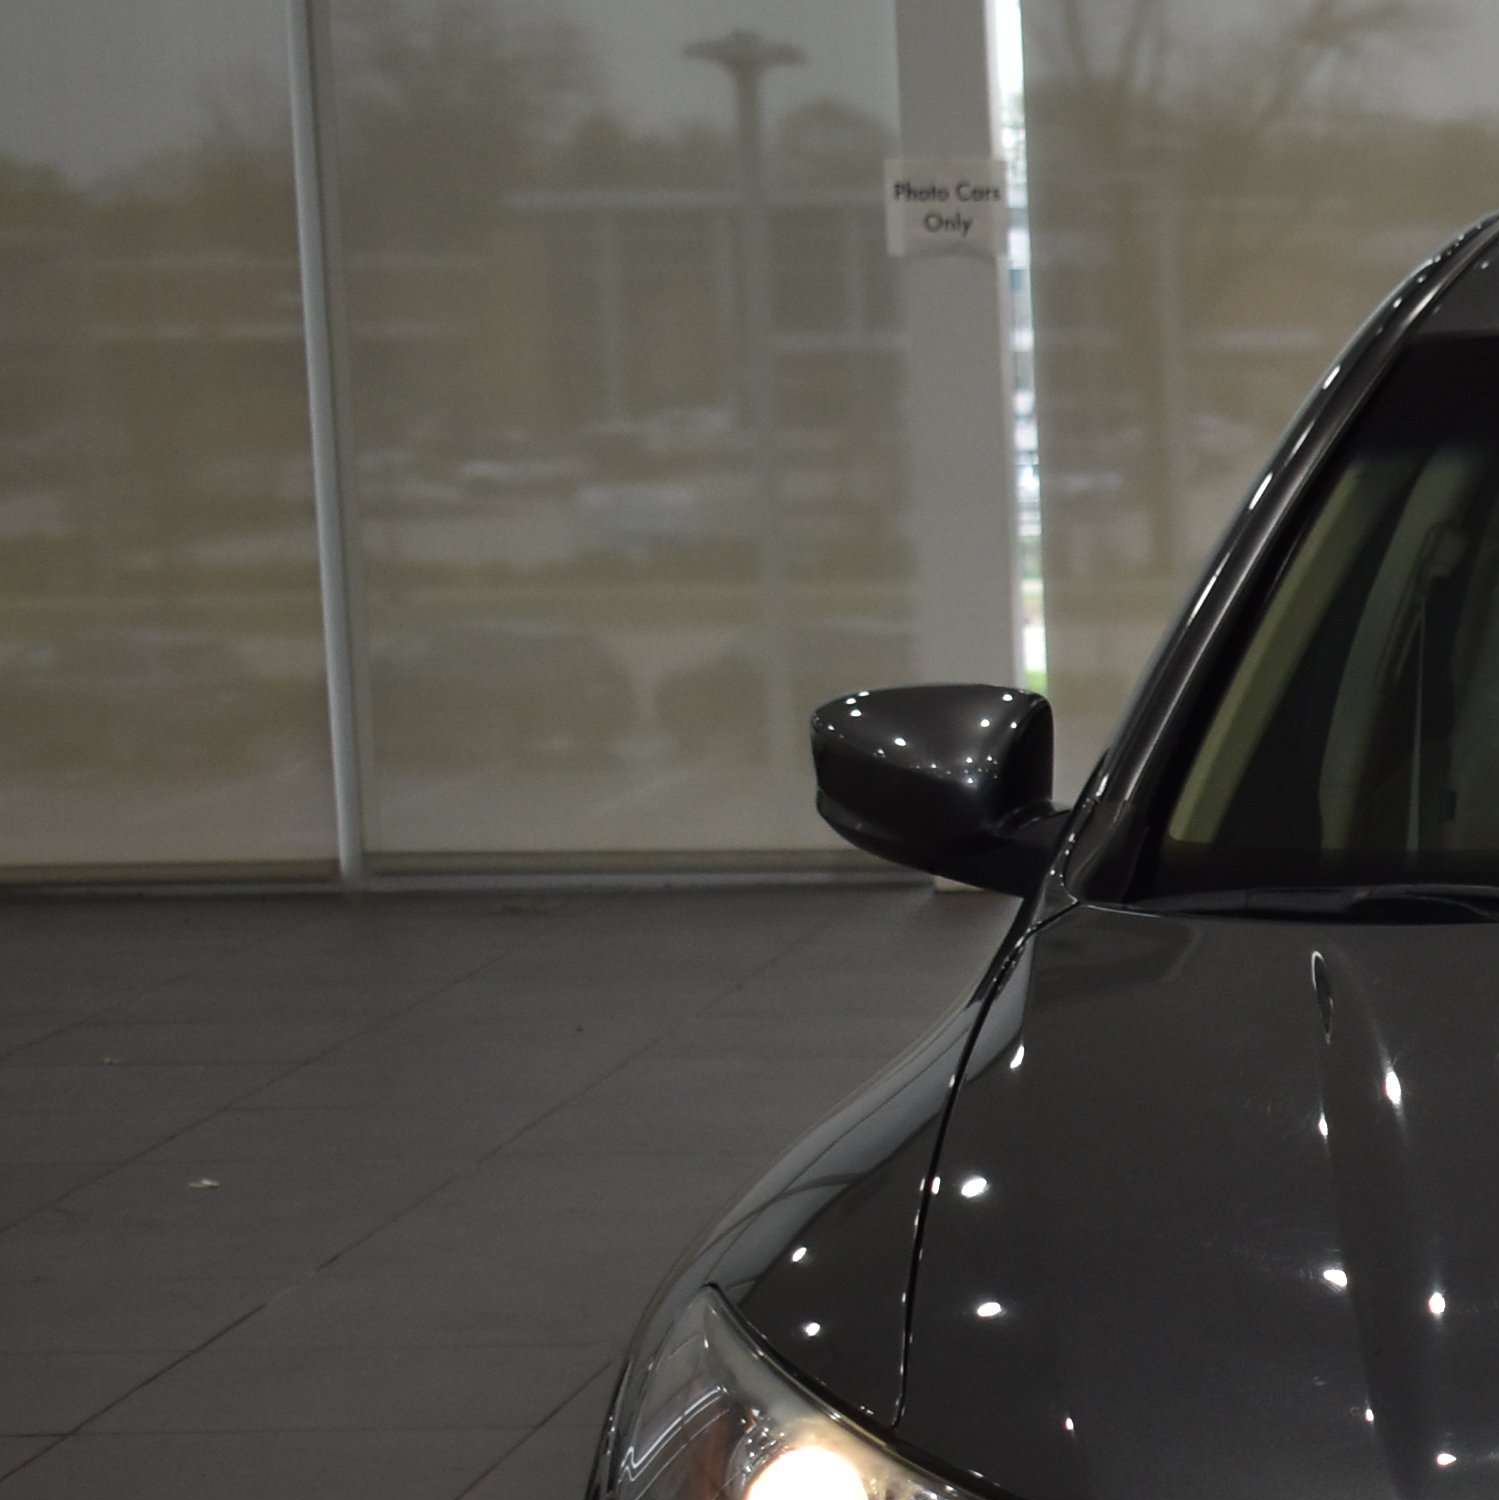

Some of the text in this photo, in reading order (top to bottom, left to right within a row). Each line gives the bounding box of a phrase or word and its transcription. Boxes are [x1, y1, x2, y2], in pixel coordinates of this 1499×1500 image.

[894, 181, 1000, 201] Photo Cars
[924, 211, 973, 238] Only
